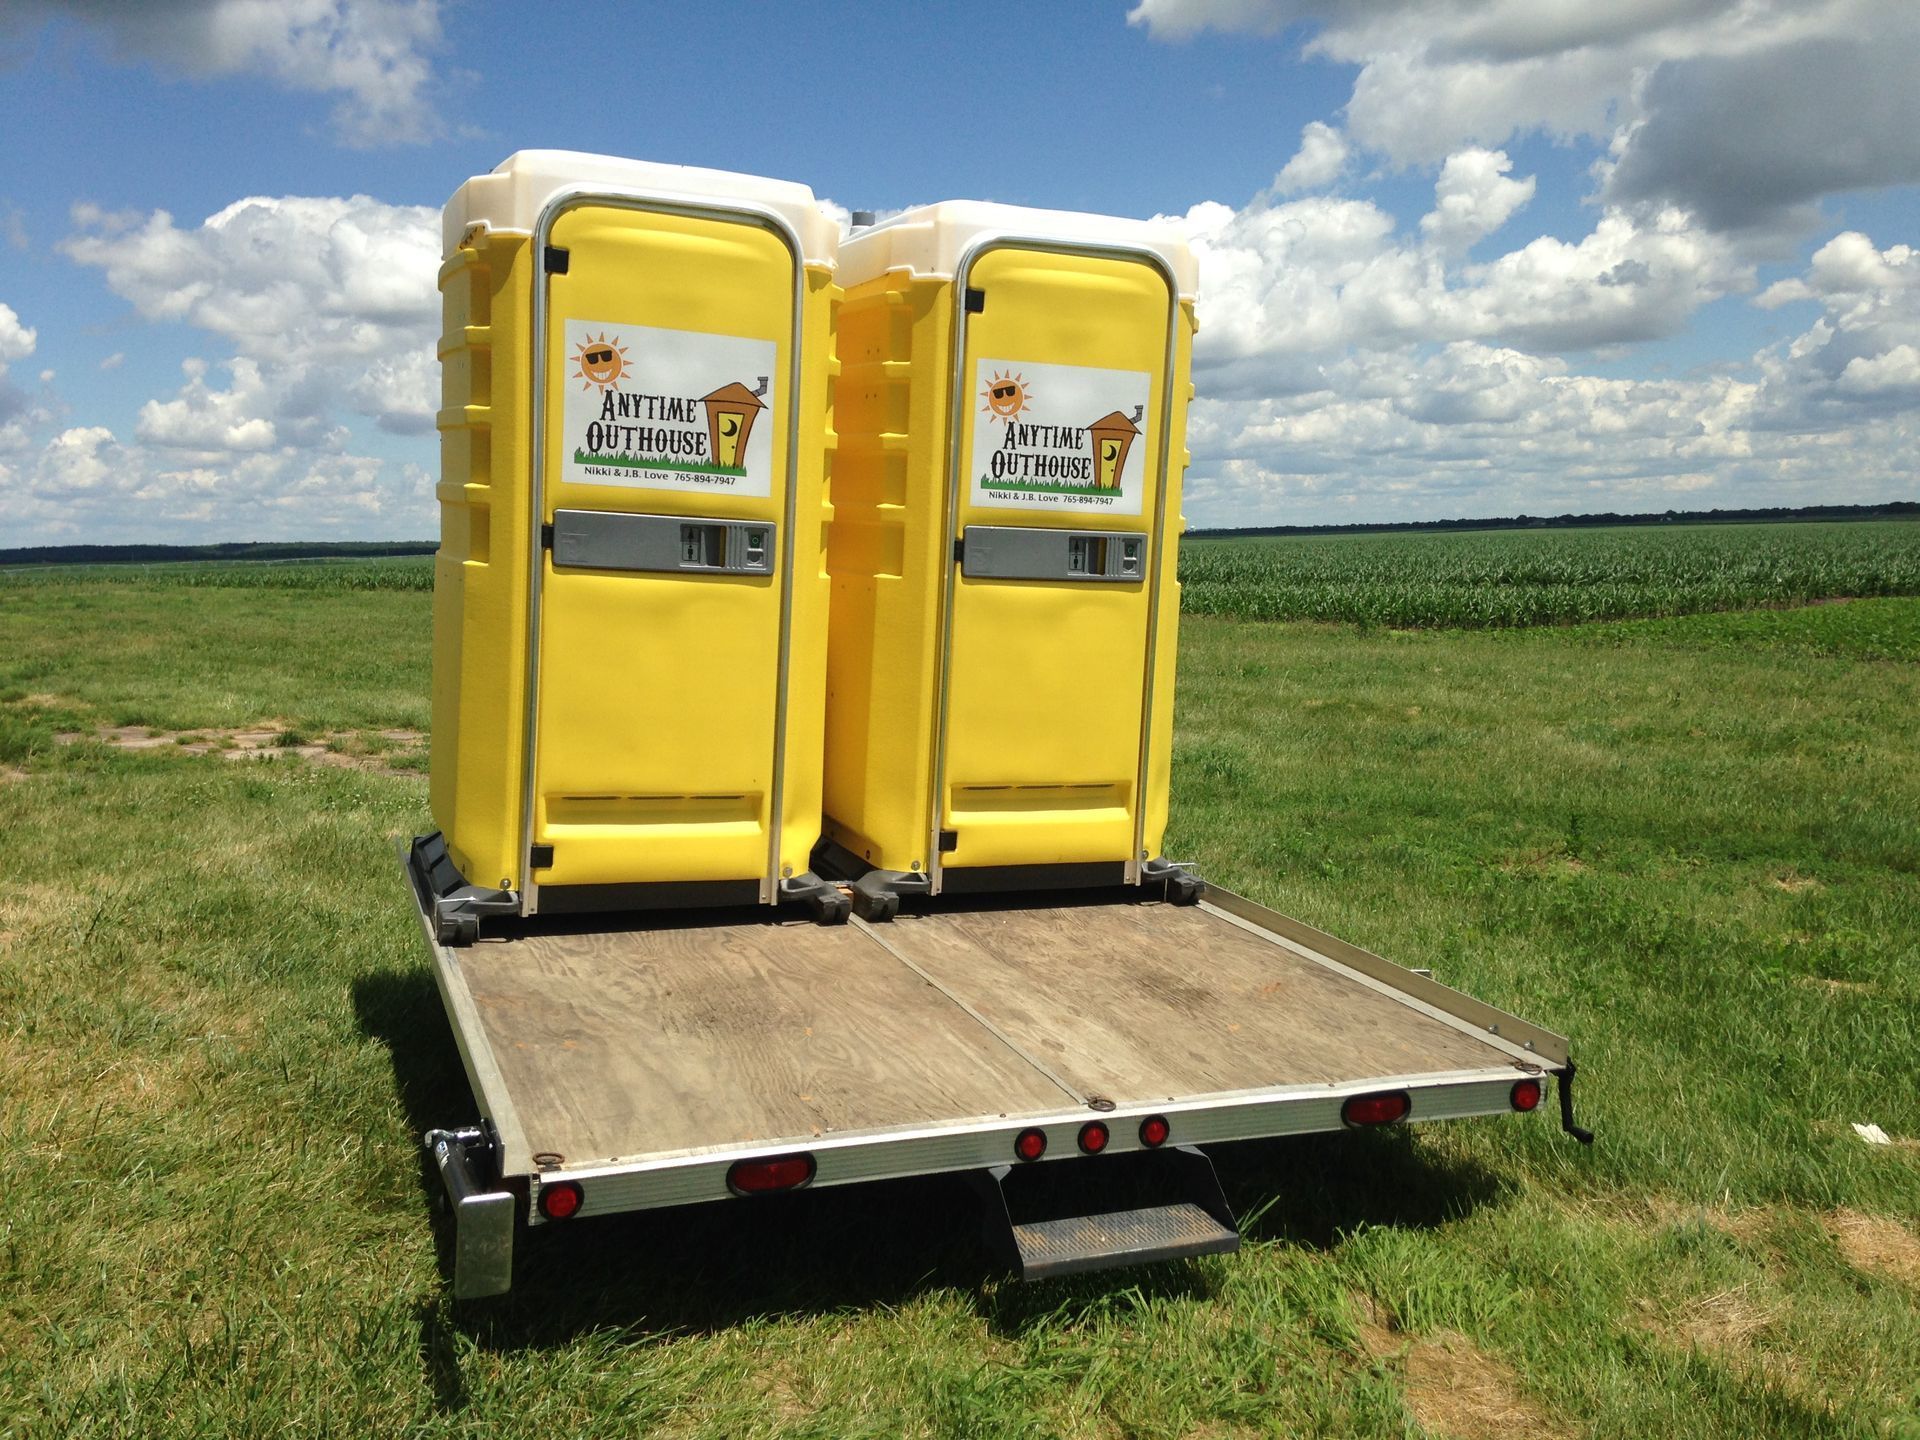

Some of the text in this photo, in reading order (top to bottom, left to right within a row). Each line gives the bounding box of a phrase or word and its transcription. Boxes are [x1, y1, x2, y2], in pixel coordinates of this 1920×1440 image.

[600, 390, 697, 423] ANYTIME
[586, 421, 707, 456] OUTHOUSE
[1002, 421, 1085, 450] ANYTIME
[584, 466, 736, 486] Nikki & J.B. Love 765-894-7947
[991, 450, 1091, 479] OUTHOUSE
[989, 491, 1011, 500] Nikki
[1022, 493, 1037, 501] J.B.
[1038, 494, 1059, 503] Love
[1063, 495, 1114, 506] 765-894-7947
